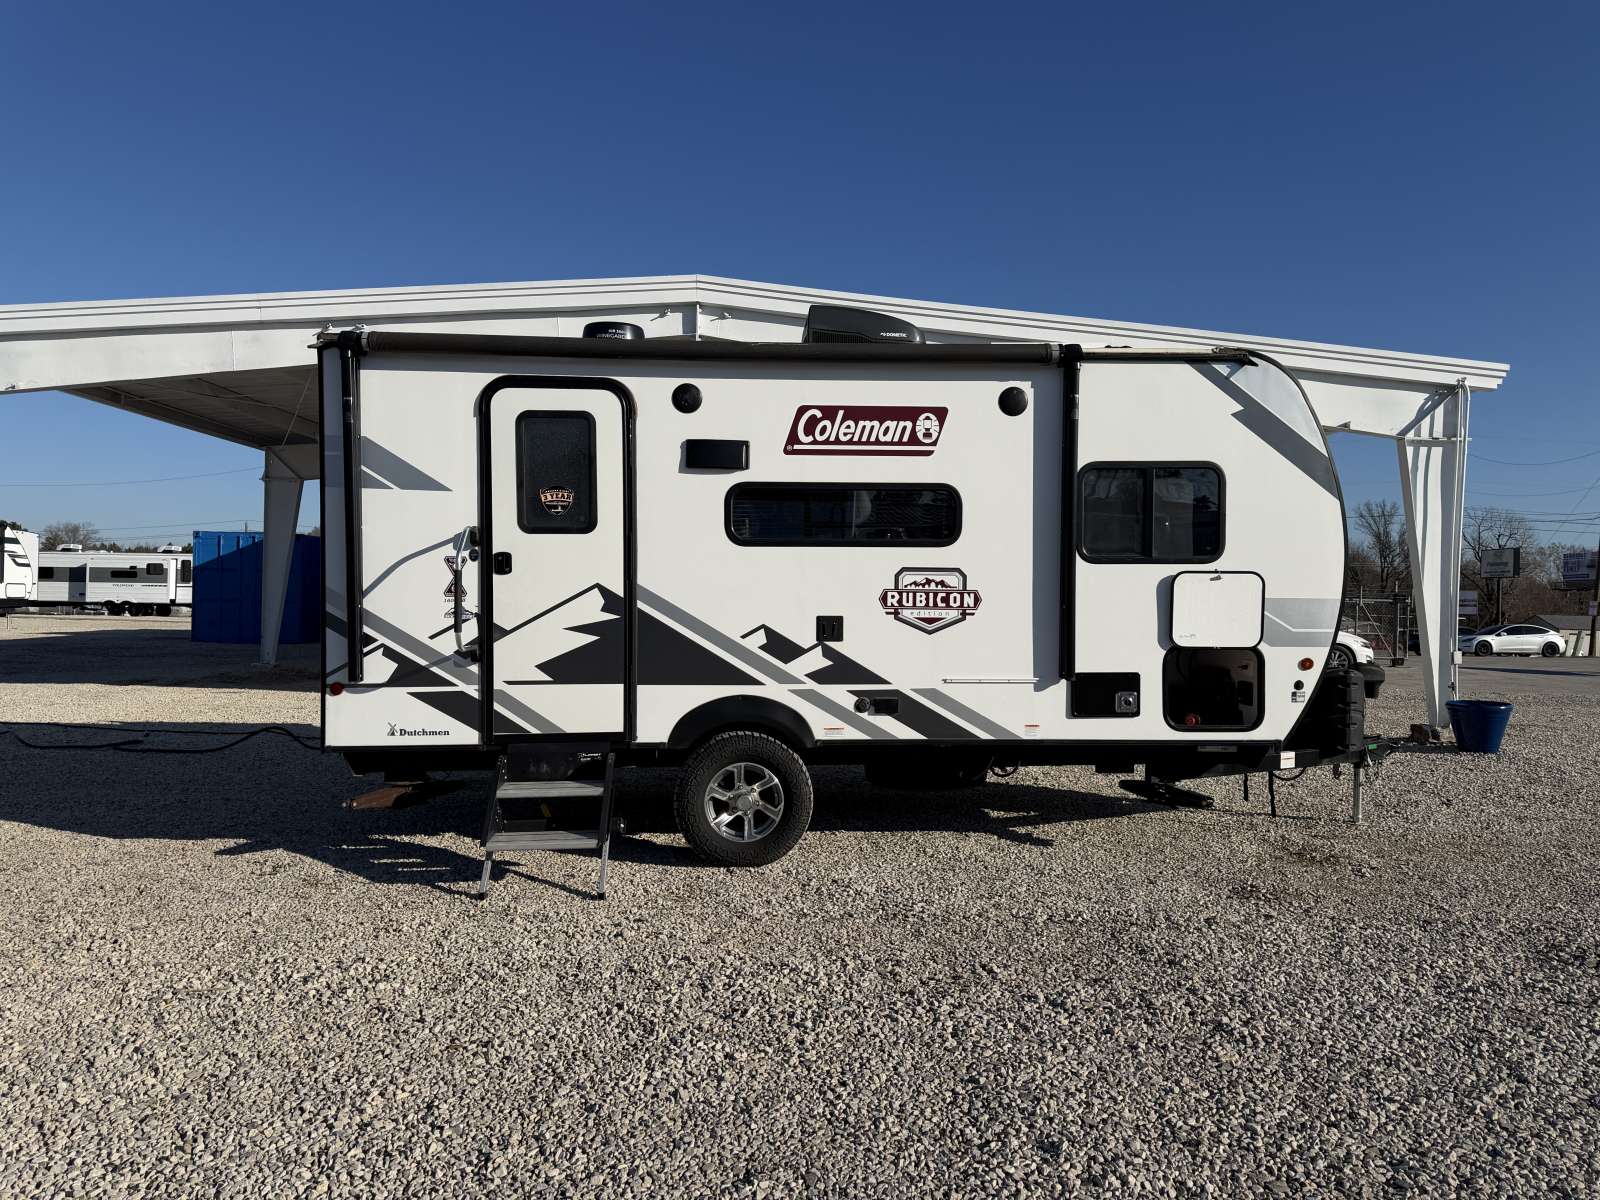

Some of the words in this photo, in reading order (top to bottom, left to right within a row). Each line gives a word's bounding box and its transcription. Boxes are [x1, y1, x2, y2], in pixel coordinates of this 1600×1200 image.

[797, 408, 913, 444] Coleman
[550, 492, 572, 501] YEAR
[886, 591, 975, 608] RUBICON
[399, 728, 450, 737] Dutchmen
